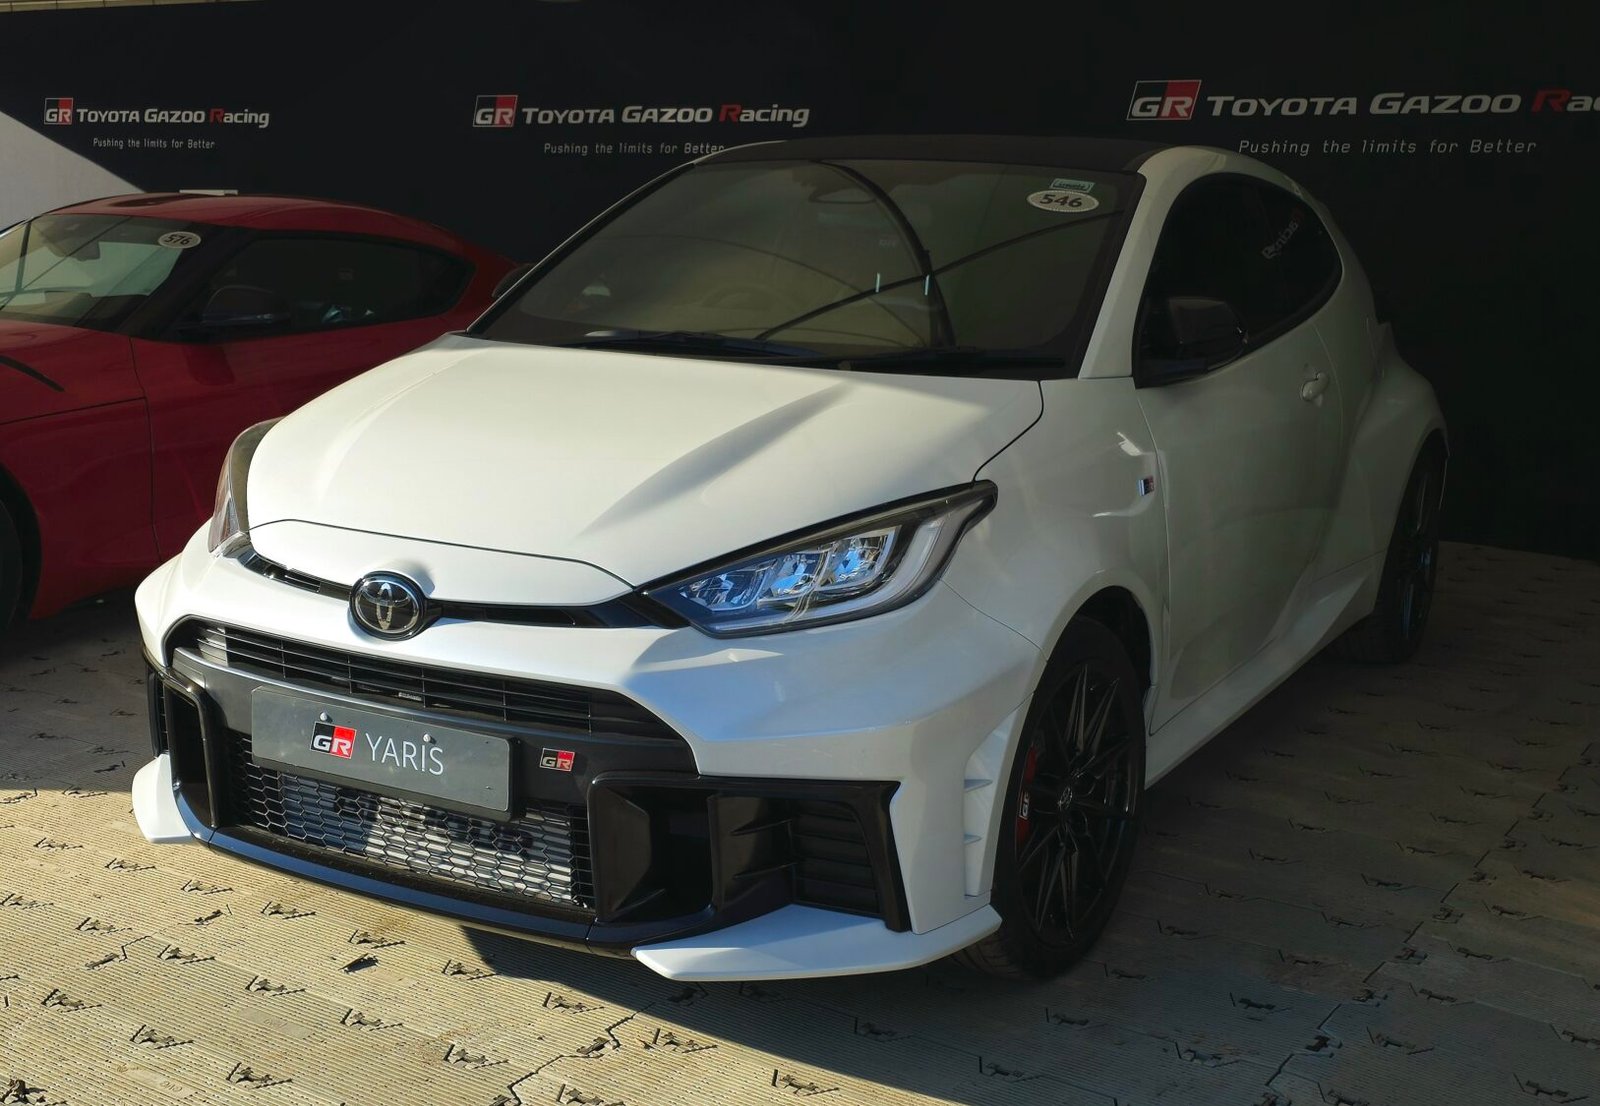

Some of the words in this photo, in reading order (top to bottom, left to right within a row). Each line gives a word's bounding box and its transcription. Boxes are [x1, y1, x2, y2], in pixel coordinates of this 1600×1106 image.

[1131, 96, 1193, 117] GR
[1206, 95, 1358, 117] TOYOTA
[1369, 92, 1522, 115] GAZOO
[1531, 88, 1600, 112] Ra
[45, 108, 71, 122] GR
[76, 108, 140, 123] TOYOTA
[143, 108, 206, 123] GAZOO
[209, 108, 270, 129] Racing
[475, 108, 514, 125] GR
[521, 107, 615, 125] TOYOTA
[621, 105, 713, 124] GAZOO
[718, 103, 810, 128] Racing
[93, 137, 124, 150] Pushing
[127, 138, 141, 148] the
[143, 138, 168, 149] limits
[171, 138, 184, 149] for
[187, 138, 216, 149] Better
[543, 142, 588, 157] Pushing
[595, 143, 613, 154] the
[618, 142, 653, 154] limits
[659, 142, 678, 154] for
[683, 142, 725, 154] Better
[1238, 139, 1311, 156] Pushing
[1322, 139, 1351, 154] the
[1361, 139, 1417, 154] limits
[1429, 139, 1459, 154] for
[1469, 139, 1537, 154] Better
[1039, 193, 1083, 208] 546
[164, 234, 193, 246] 576
[312, 734, 353, 757] GR
[365, 732, 444, 776] YARIS
[542, 756, 572, 770] GR
